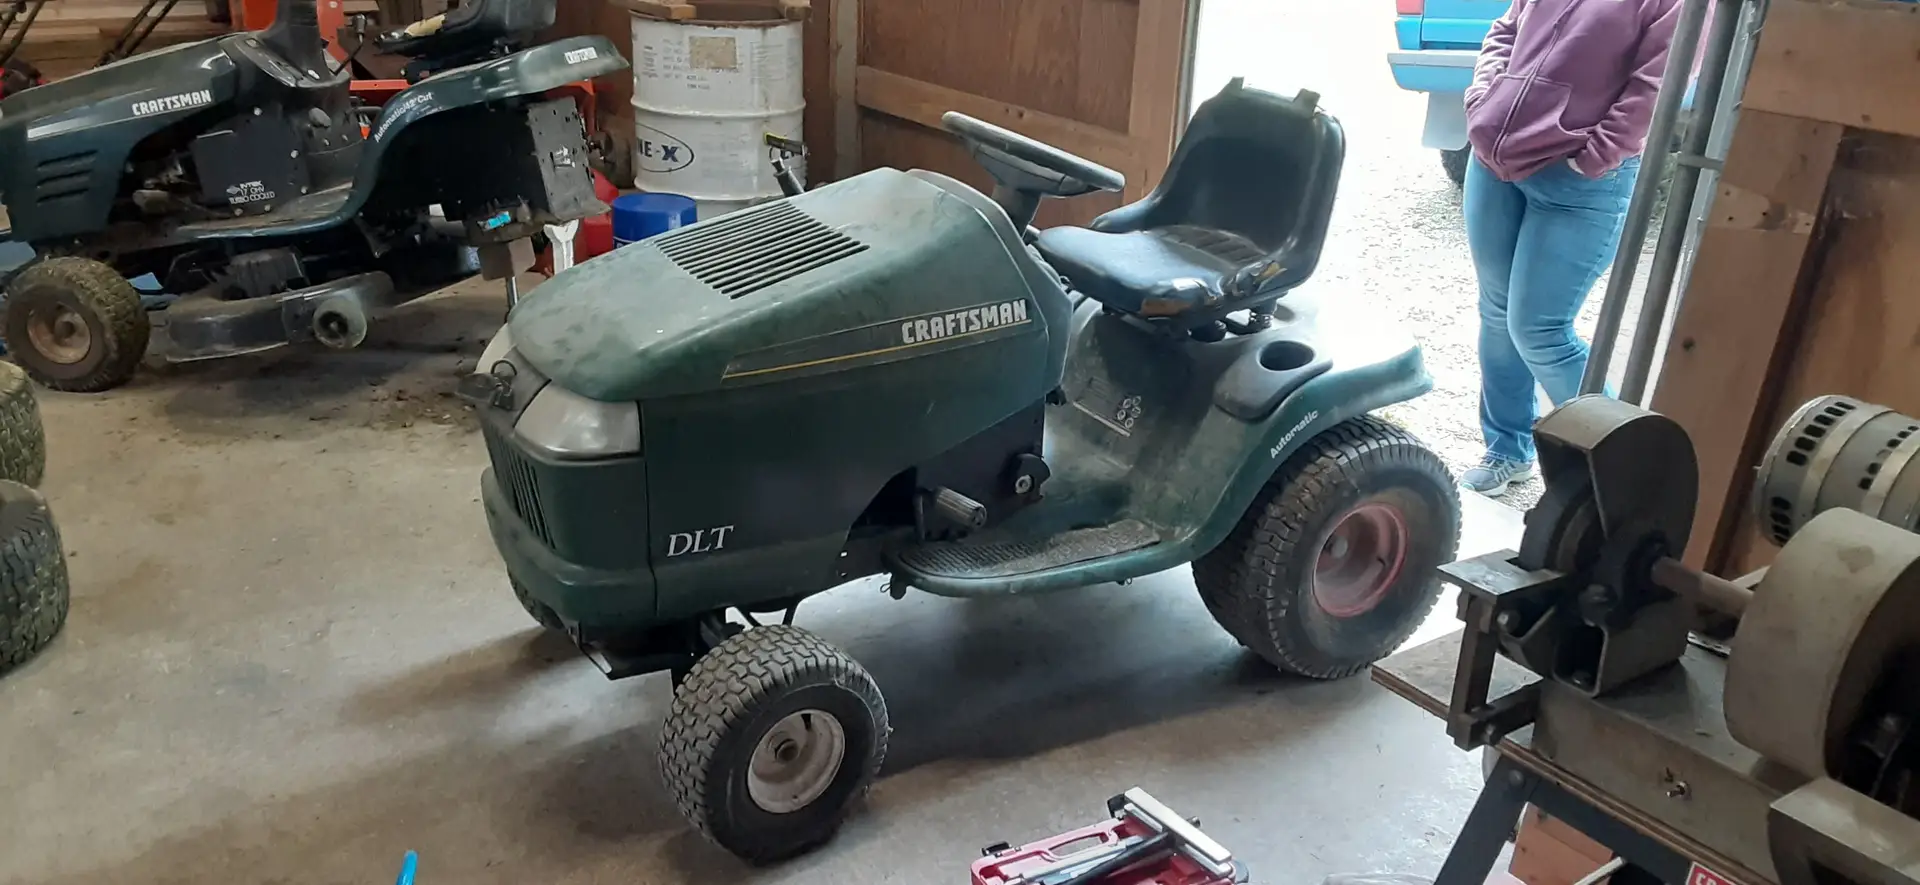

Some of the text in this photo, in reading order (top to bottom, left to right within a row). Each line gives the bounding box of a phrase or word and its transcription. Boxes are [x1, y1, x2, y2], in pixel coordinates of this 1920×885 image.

[132, 89, 212, 116] CRAFTSMAN
[417, 92, 433, 104] Cut
[901, 299, 1027, 344] CRAFTSMAN
[1270, 410, 1318, 459] Automatic
[667, 525, 735, 557] DLT
